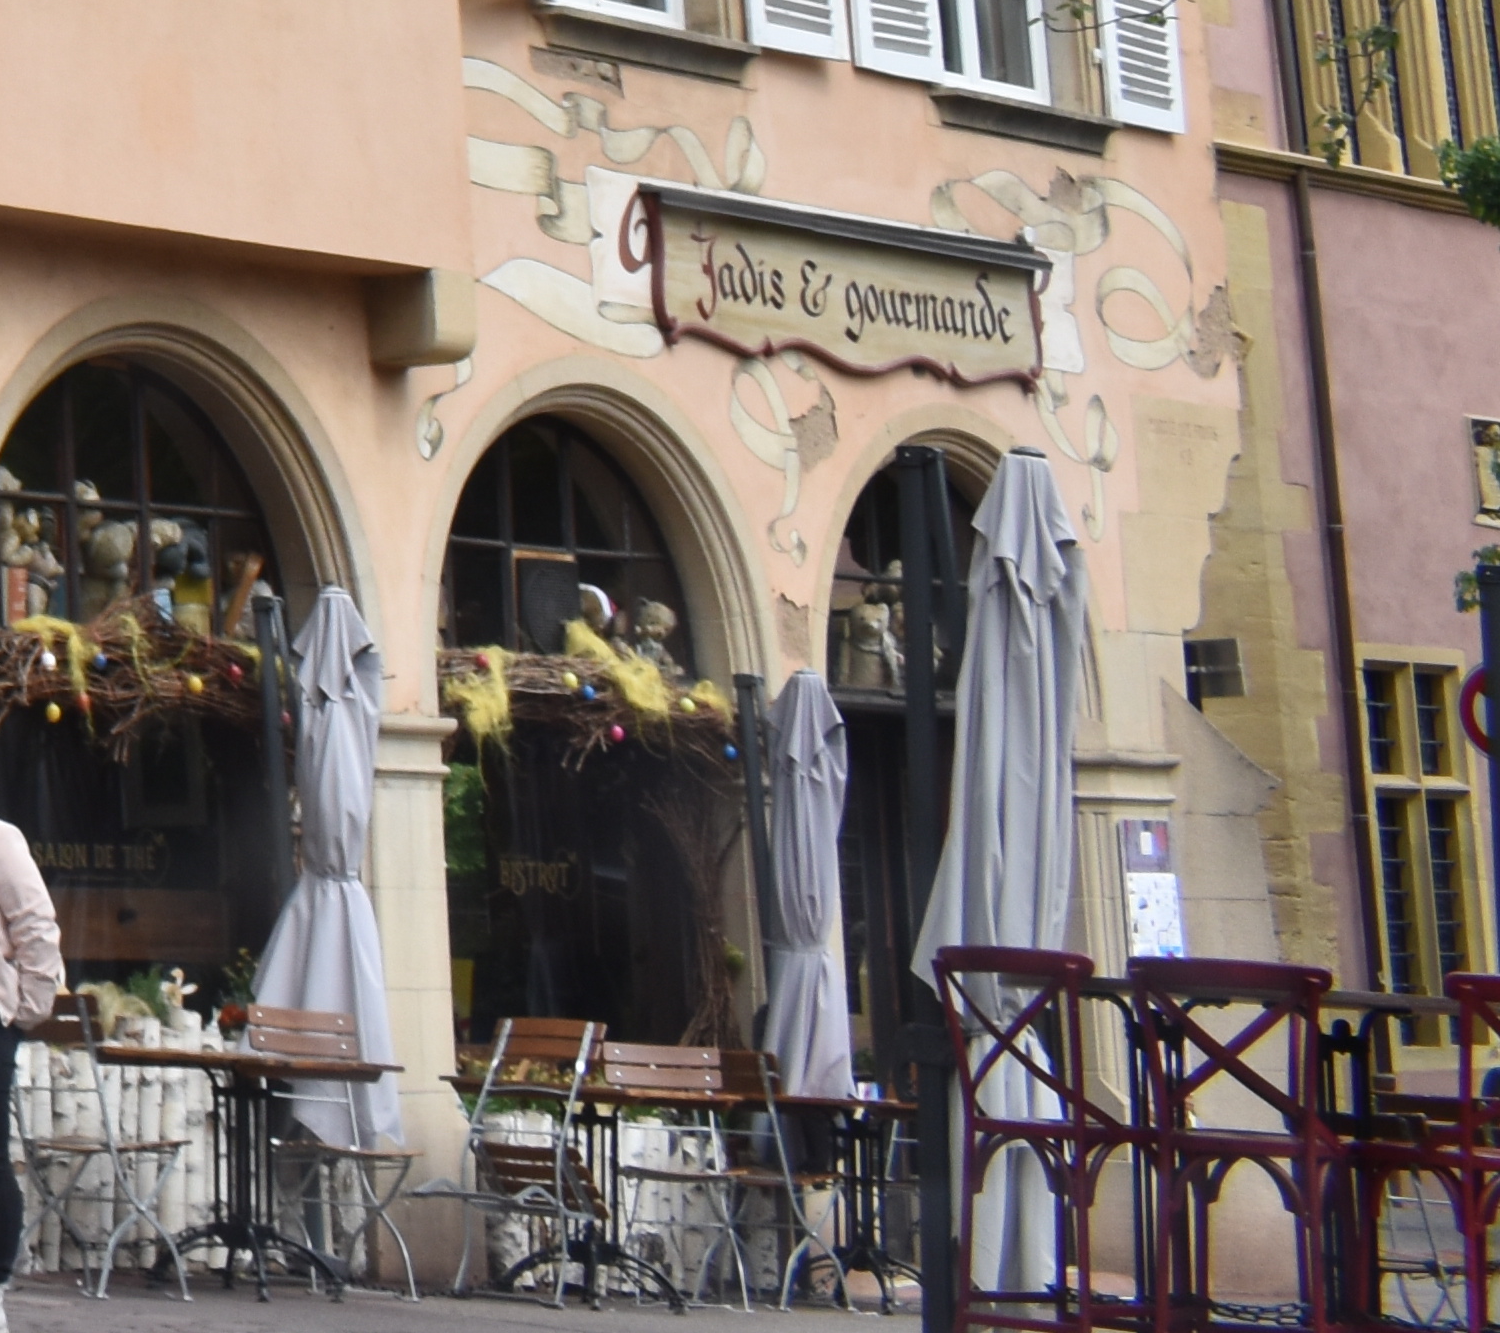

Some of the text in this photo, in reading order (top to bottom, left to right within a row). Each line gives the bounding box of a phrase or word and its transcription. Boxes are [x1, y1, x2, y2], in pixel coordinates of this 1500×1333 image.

[690, 222, 1013, 344] Jadis & gourmande
[31, 841, 88, 870] SALON
[93, 842, 115, 869] DE
